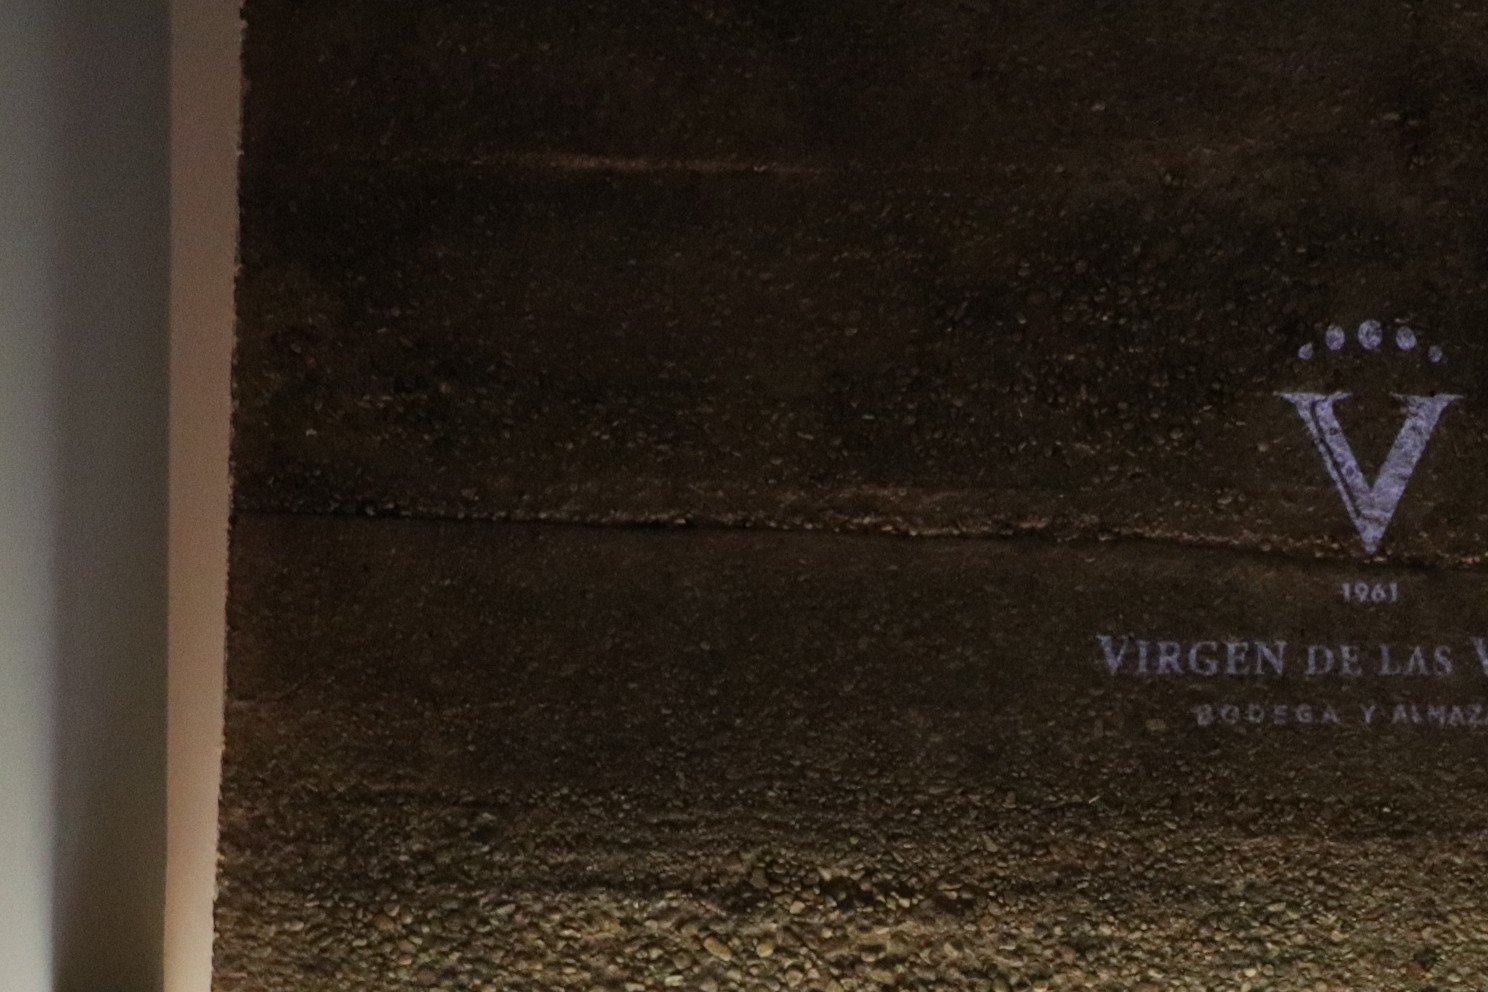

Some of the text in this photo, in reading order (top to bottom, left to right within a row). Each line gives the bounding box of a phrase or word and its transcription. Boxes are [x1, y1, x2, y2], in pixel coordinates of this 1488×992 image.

[1273, 390, 1464, 553] V
[1341, 582, 1399, 602] 1961
[1096, 635, 1288, 677] VIRGEN
[1304, 643, 1362, 677] DE
[1379, 643, 1452, 677] LAS
[1194, 703, 1340, 727] BODEGA
[1361, 704, 1380, 725] Y
